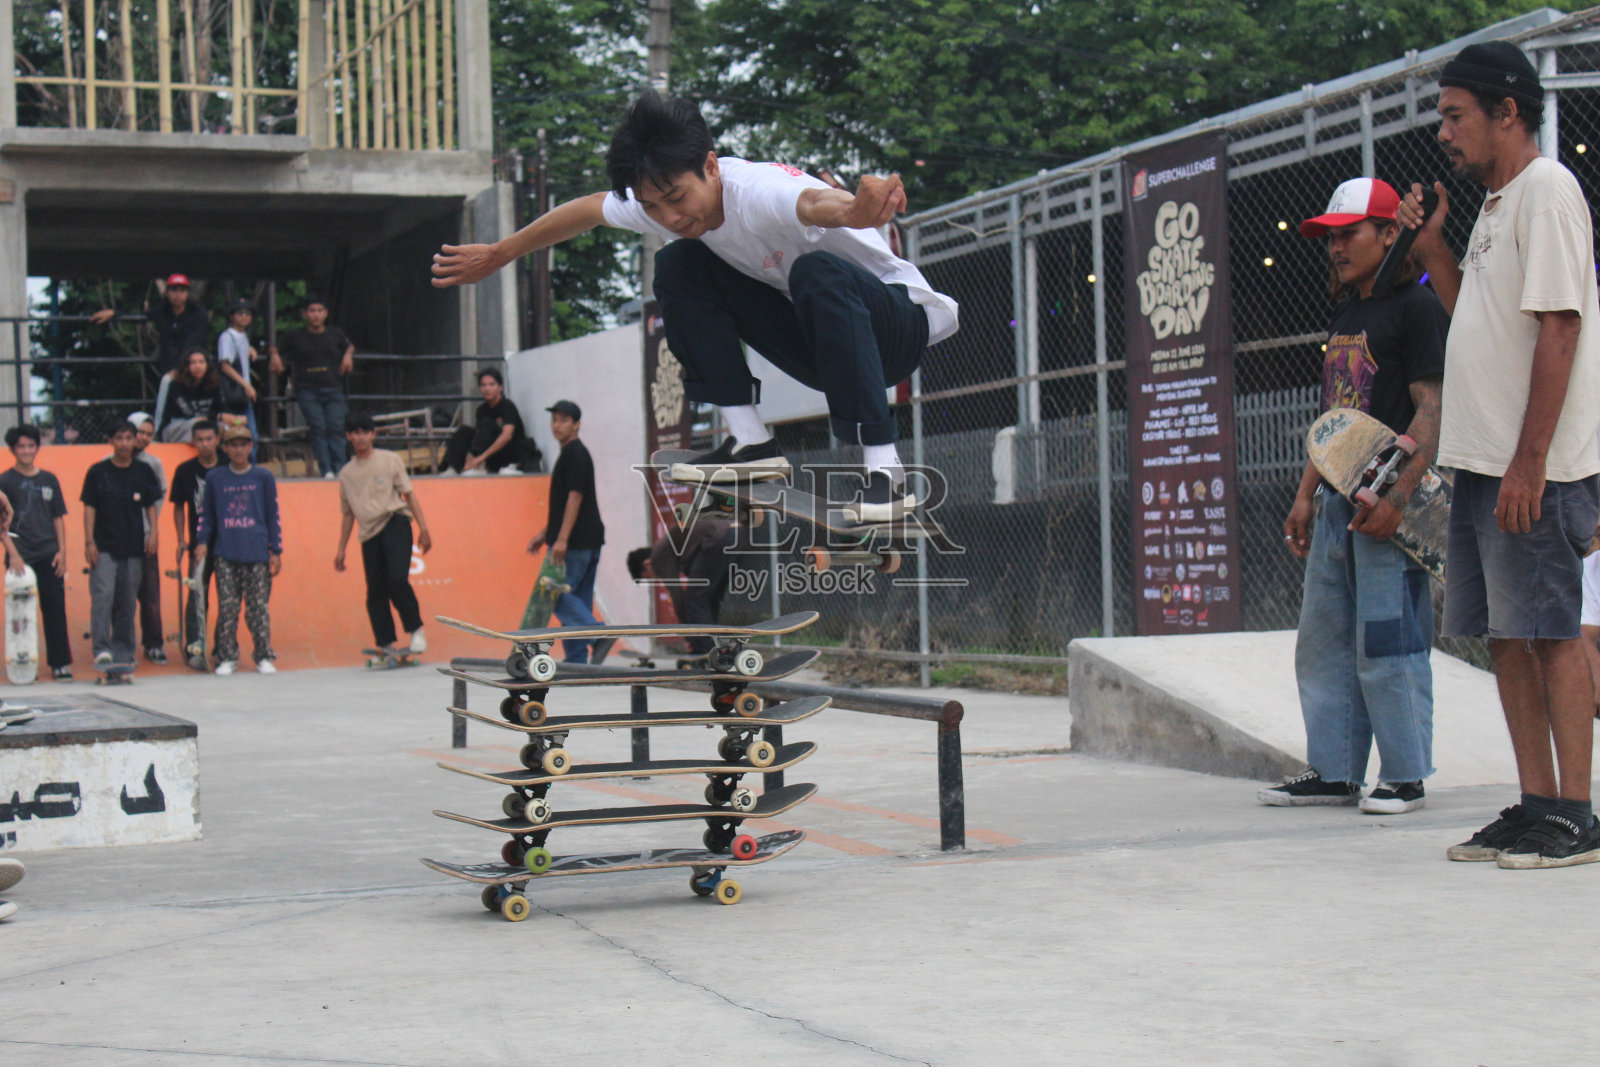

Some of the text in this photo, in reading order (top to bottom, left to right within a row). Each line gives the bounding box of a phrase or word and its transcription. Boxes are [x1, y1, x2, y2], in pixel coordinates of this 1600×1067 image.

[1148, 156, 1217, 188] SUPERCHALLENGE
[1154, 200, 1200, 249] GO
[1147, 235, 1206, 284] SKATE
[1136, 262, 1216, 317] BOARDING
[1150, 286, 1210, 341] DAY
